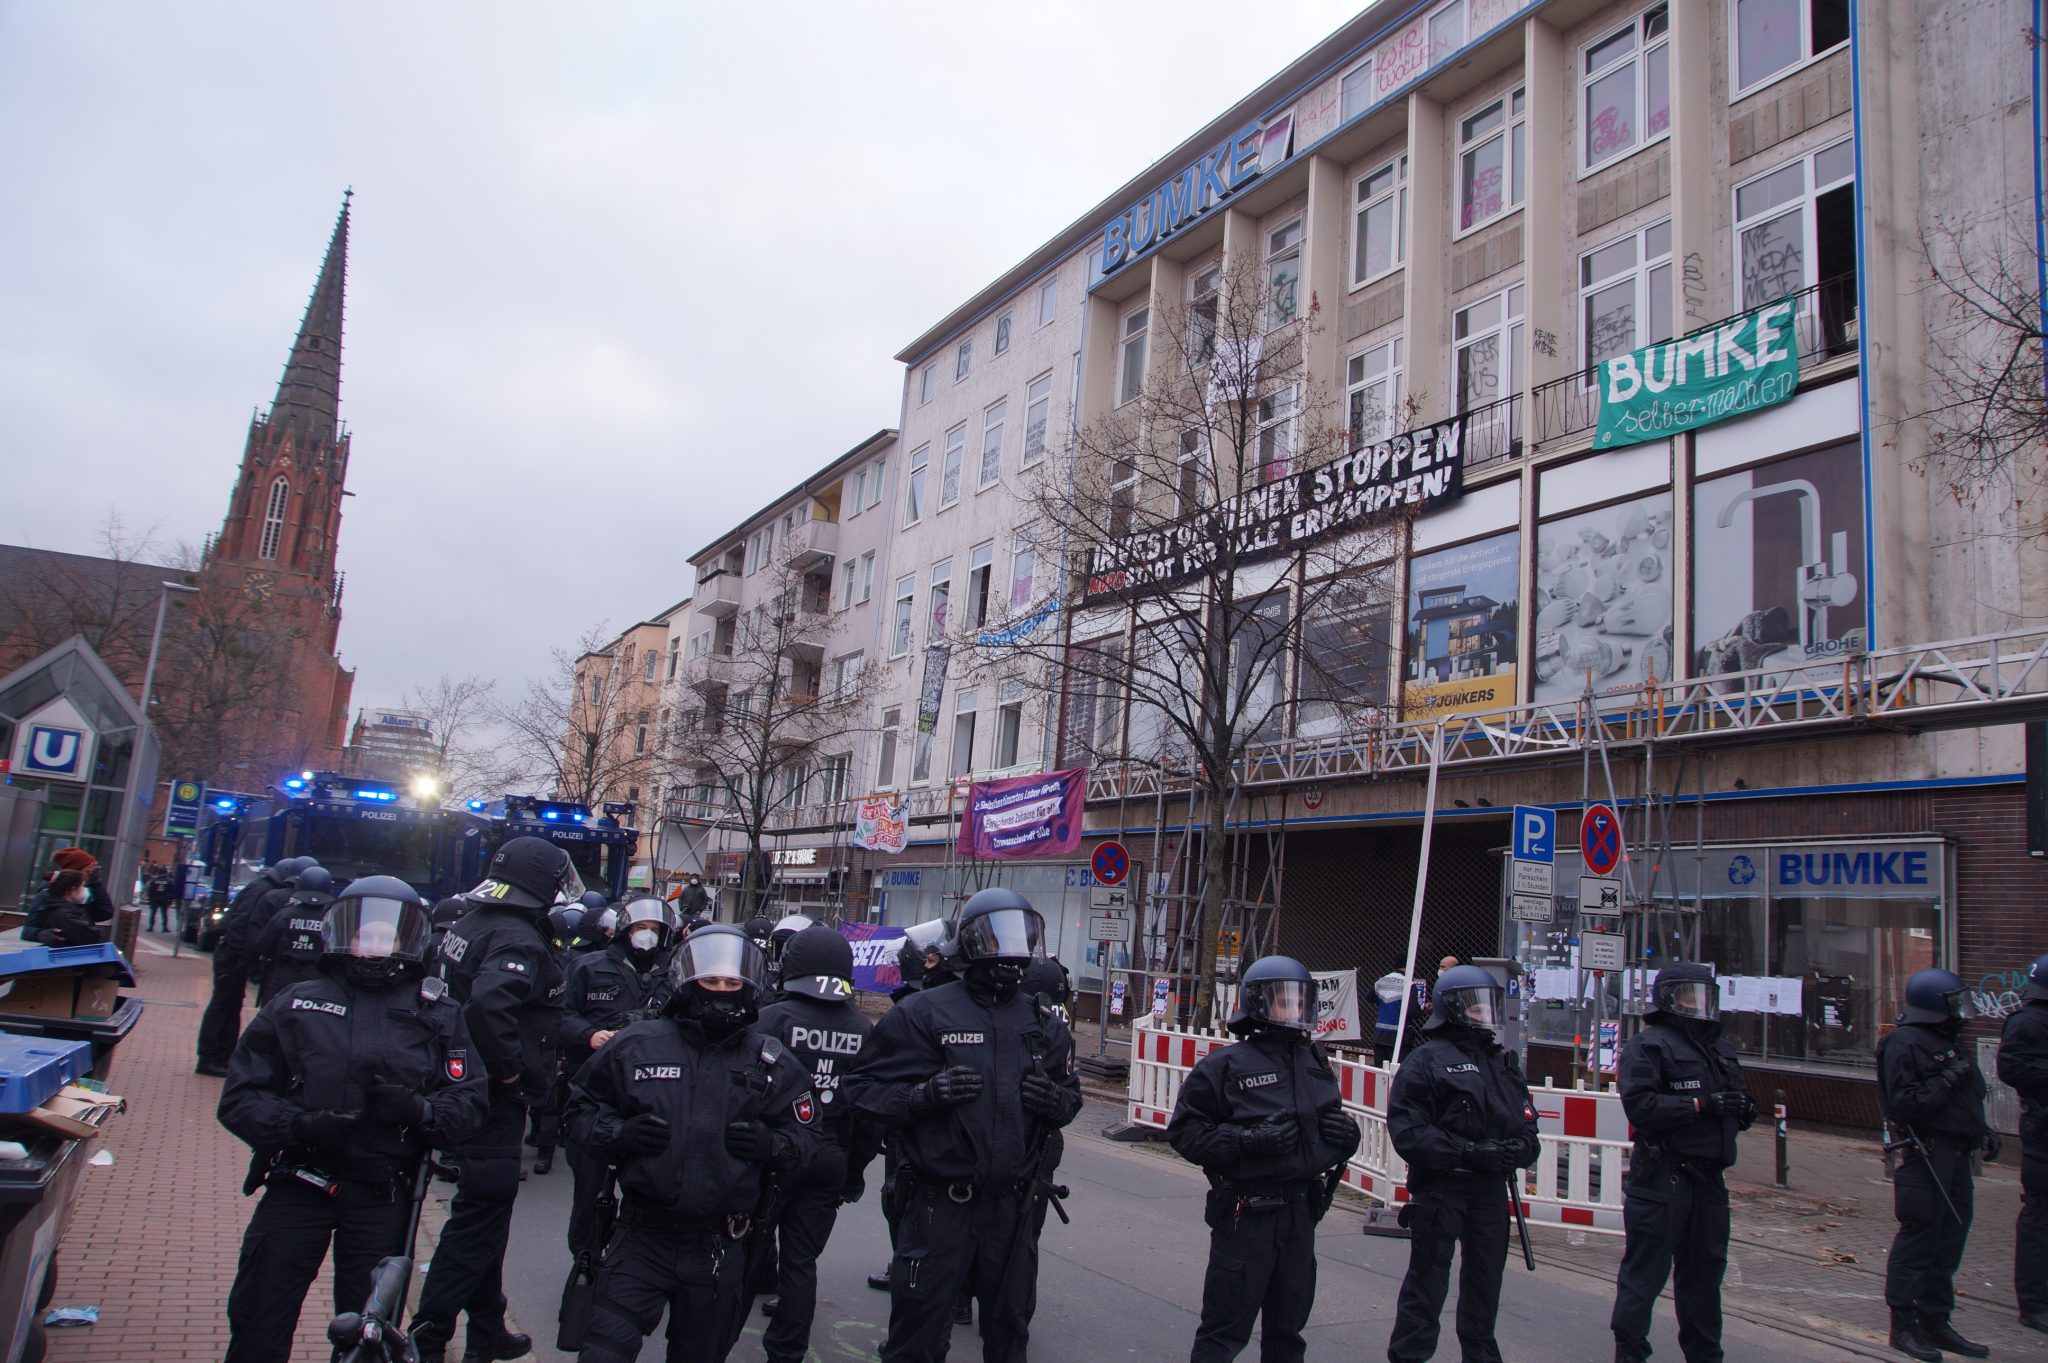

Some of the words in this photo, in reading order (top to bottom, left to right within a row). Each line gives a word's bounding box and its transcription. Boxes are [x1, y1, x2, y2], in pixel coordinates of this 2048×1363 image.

[1379, 29, 1424, 71] WIR
[1102, 120, 1264, 274] BUMKE
[1608, 301, 1792, 403] BUMKE
[1313, 420, 1460, 502] STOPPEN
[1291, 466, 1452, 540] ERKÄMPFEN!
[1468, 545, 1499, 560] Antwort
[1804, 636, 1859, 655] GROHE
[1437, 689, 1494, 708] JUNKERS
[33, 731, 77, 767] U
[361, 810, 397, 821] POLIZEI
[552, 830, 584, 841] POLIZEI
[1523, 813, 1546, 853] P
[496, 853, 505, 862] 23
[1779, 851, 1928, 885] BUMKE
[891, 871, 920, 886] BUMKE
[289, 918, 323, 932] POLIZEI
[292, 941, 313, 950] 7214
[753, 938, 767, 948] 72
[816, 976, 845, 996] 72
[1509, 979, 1517, 994] P
[292, 998, 347, 1017] POLIZEI
[1051, 1005, 1069, 1022] 72
[792, 1026, 862, 1055] POLIZEI
[942, 1033, 984, 1045] POLIZEI
[635, 1066, 681, 1081] POLIZEI
[817, 1058, 833, 1074] NI
